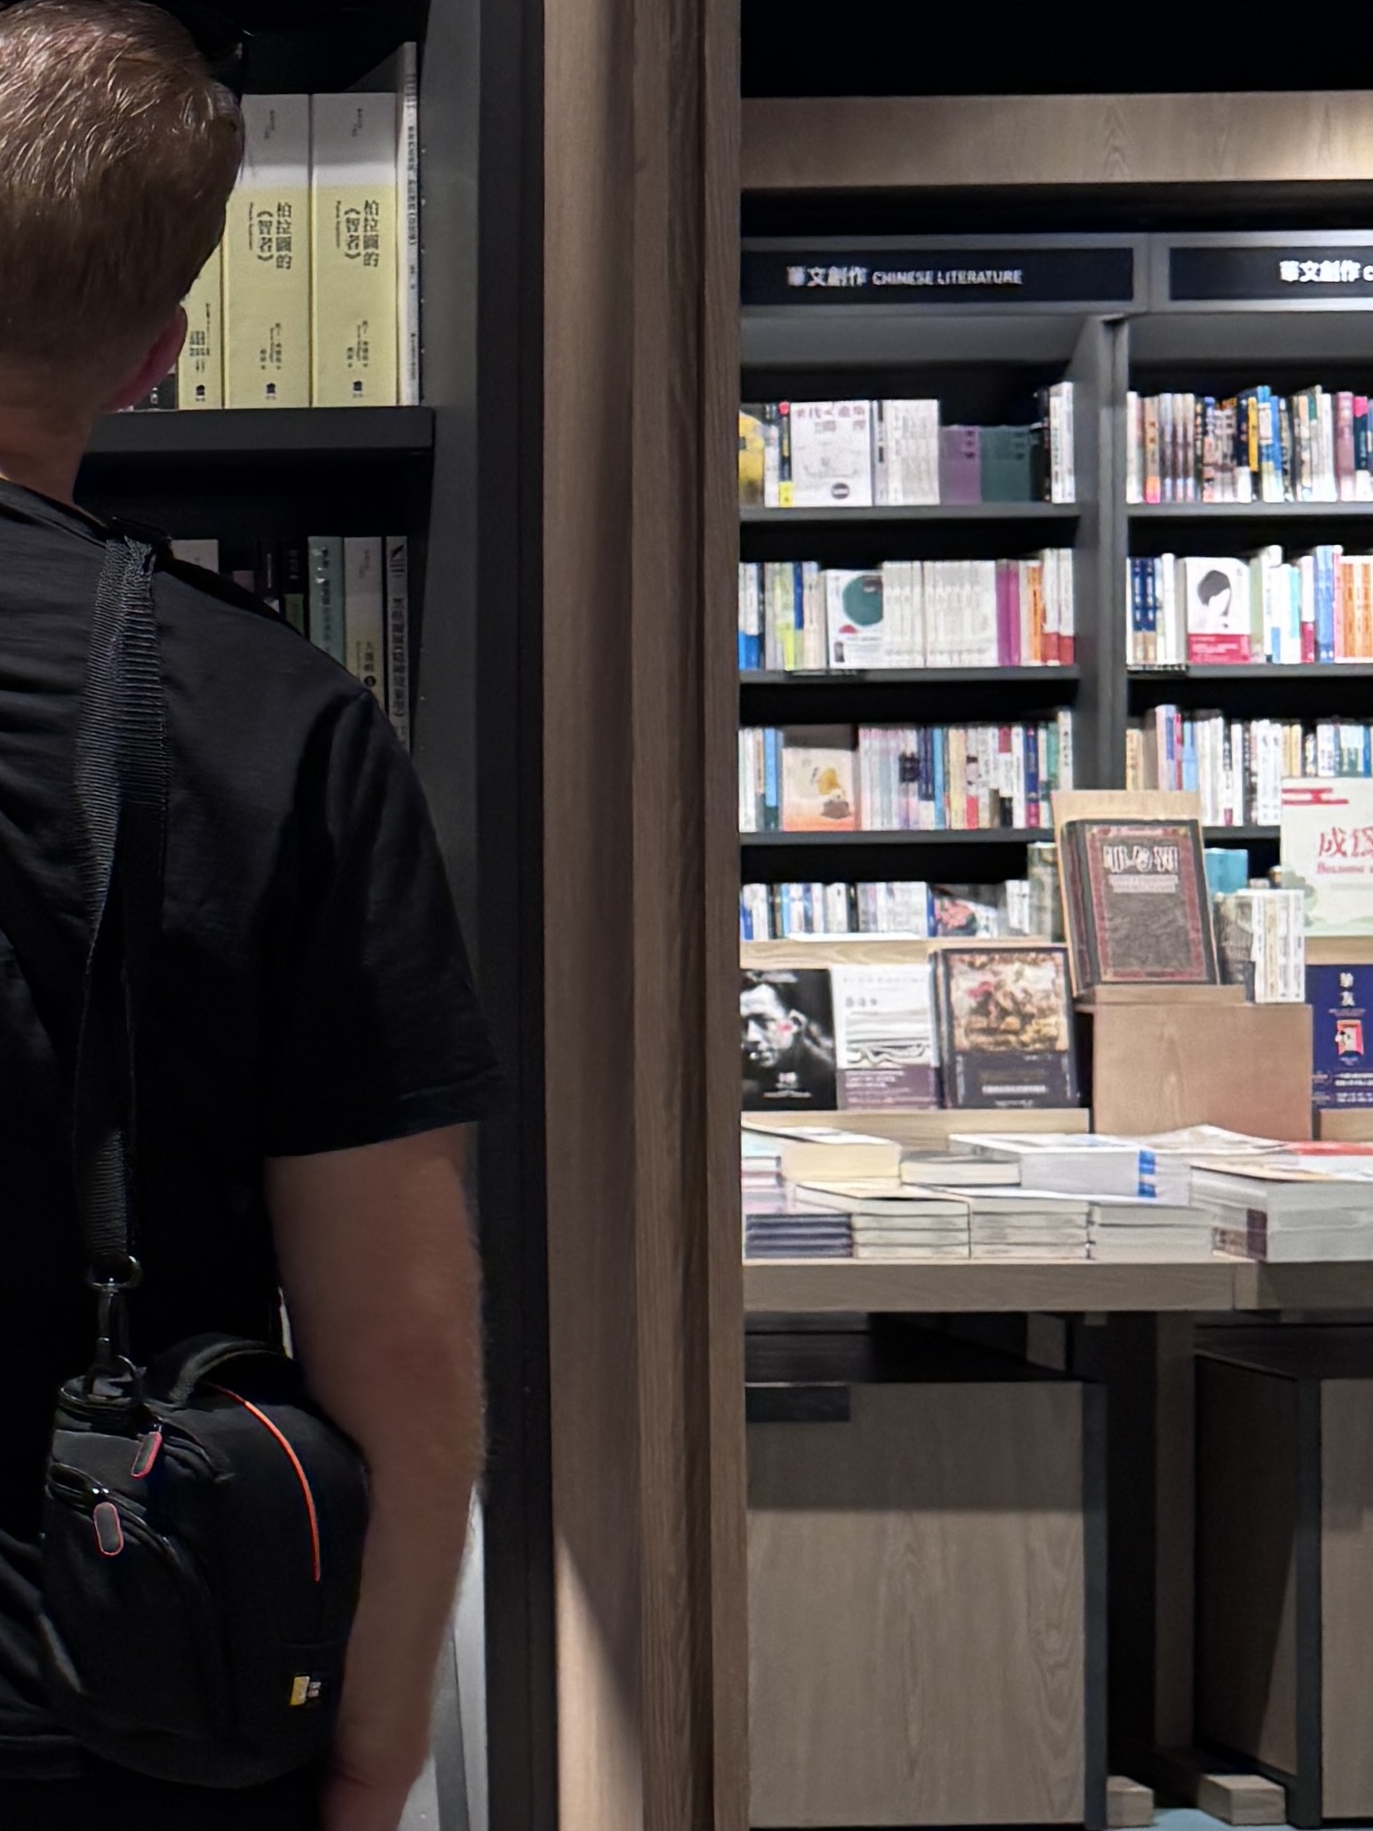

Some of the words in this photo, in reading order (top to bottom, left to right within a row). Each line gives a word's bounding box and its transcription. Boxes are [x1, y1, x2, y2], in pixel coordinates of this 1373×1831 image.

[256, 210, 274, 262] 《智者》
[276, 202, 292, 270] 柏拉圖的
[344, 207, 361, 260] 《智者》
[363, 200, 379, 268] 柏拉圖的
